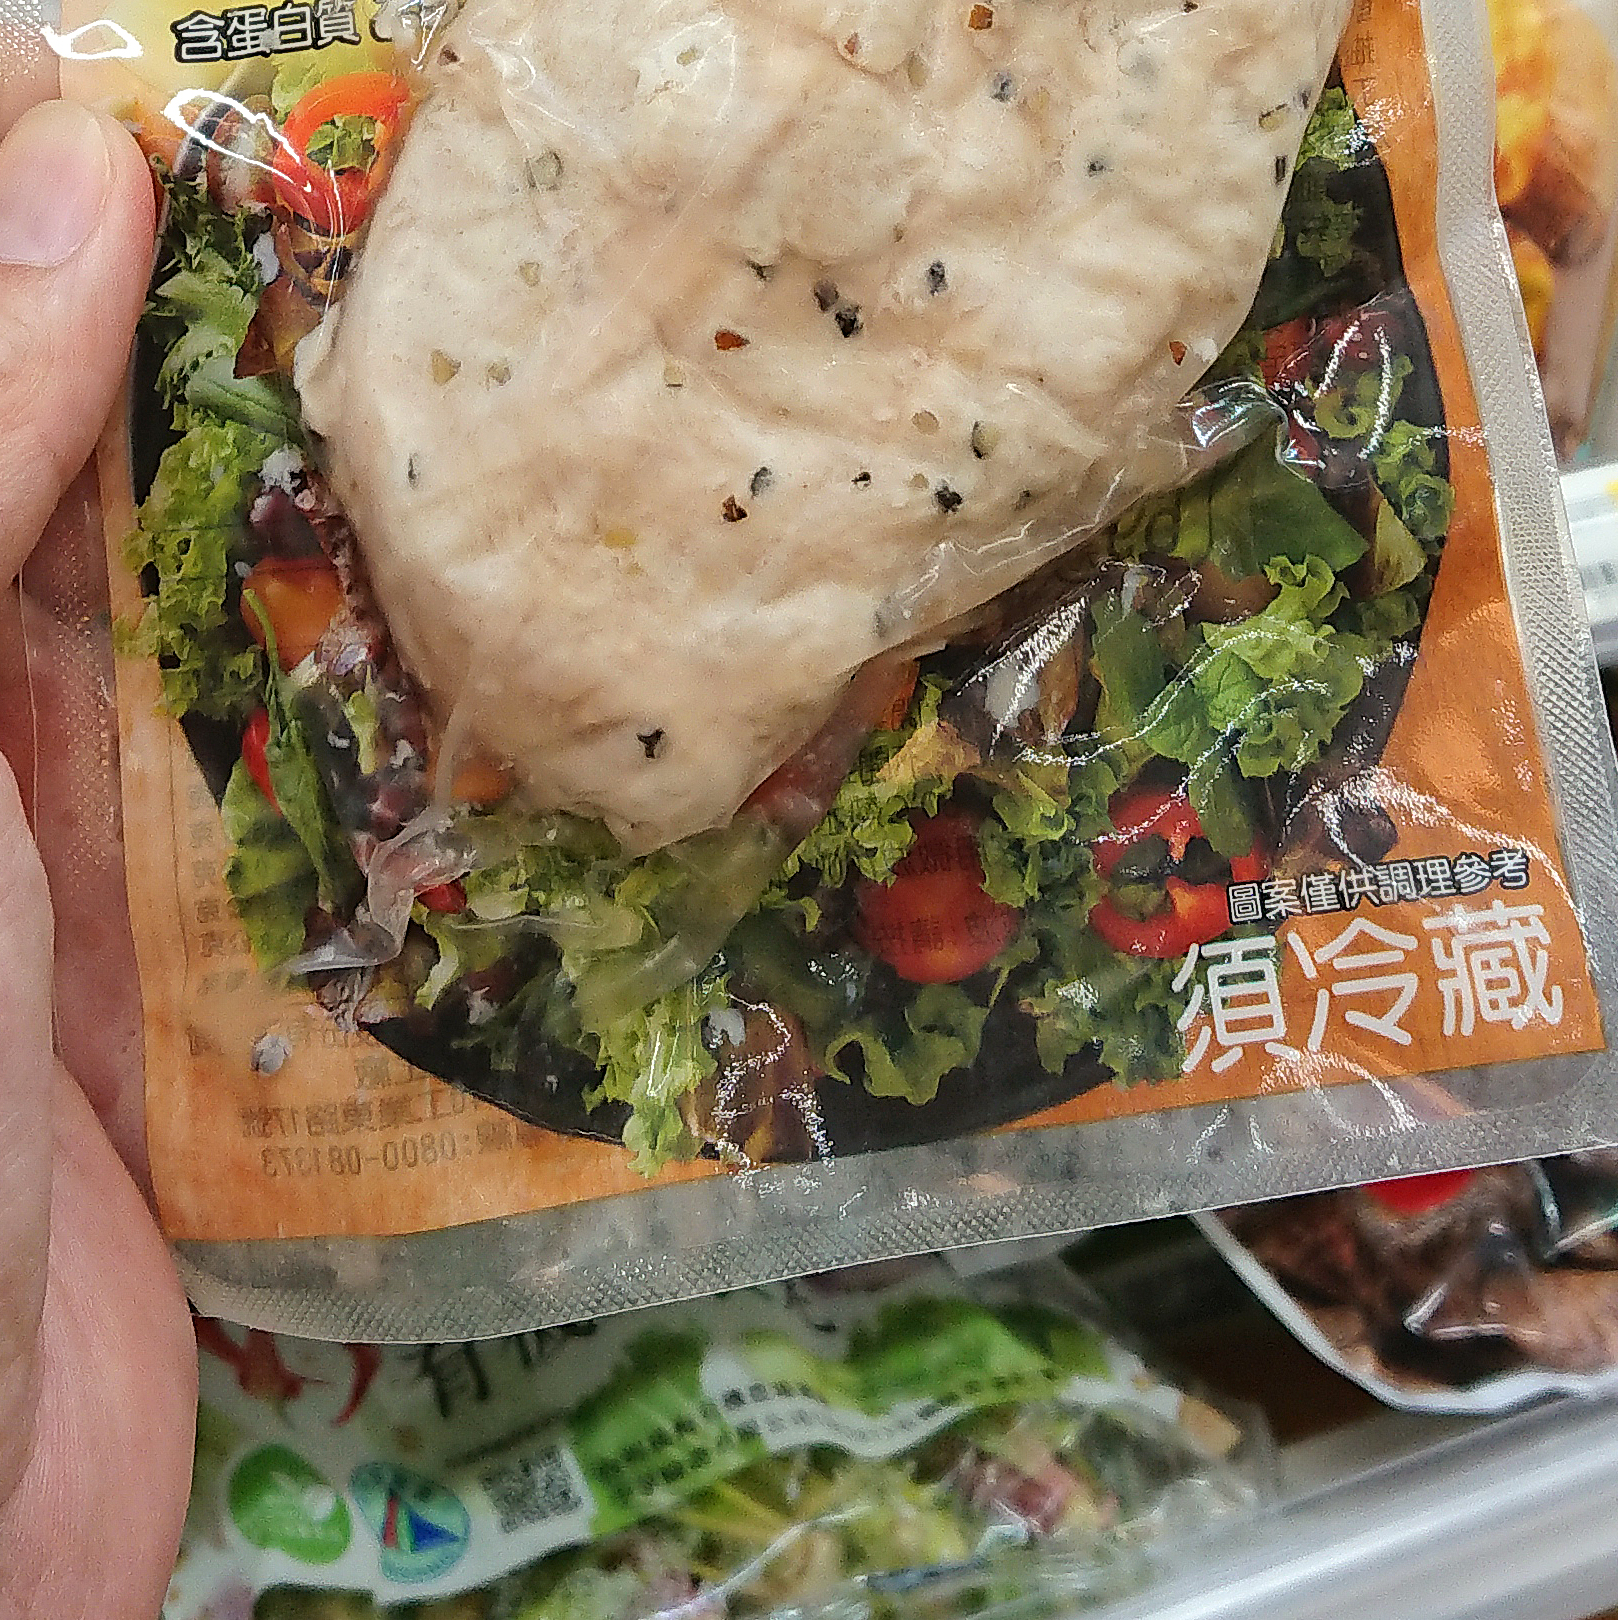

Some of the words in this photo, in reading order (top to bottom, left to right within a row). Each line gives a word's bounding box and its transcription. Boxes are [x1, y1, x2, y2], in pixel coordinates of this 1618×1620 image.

[1227, 849, 1529, 925] 圖案僅供調理參考
[1171, 900, 1563, 1074] 須冷藏
